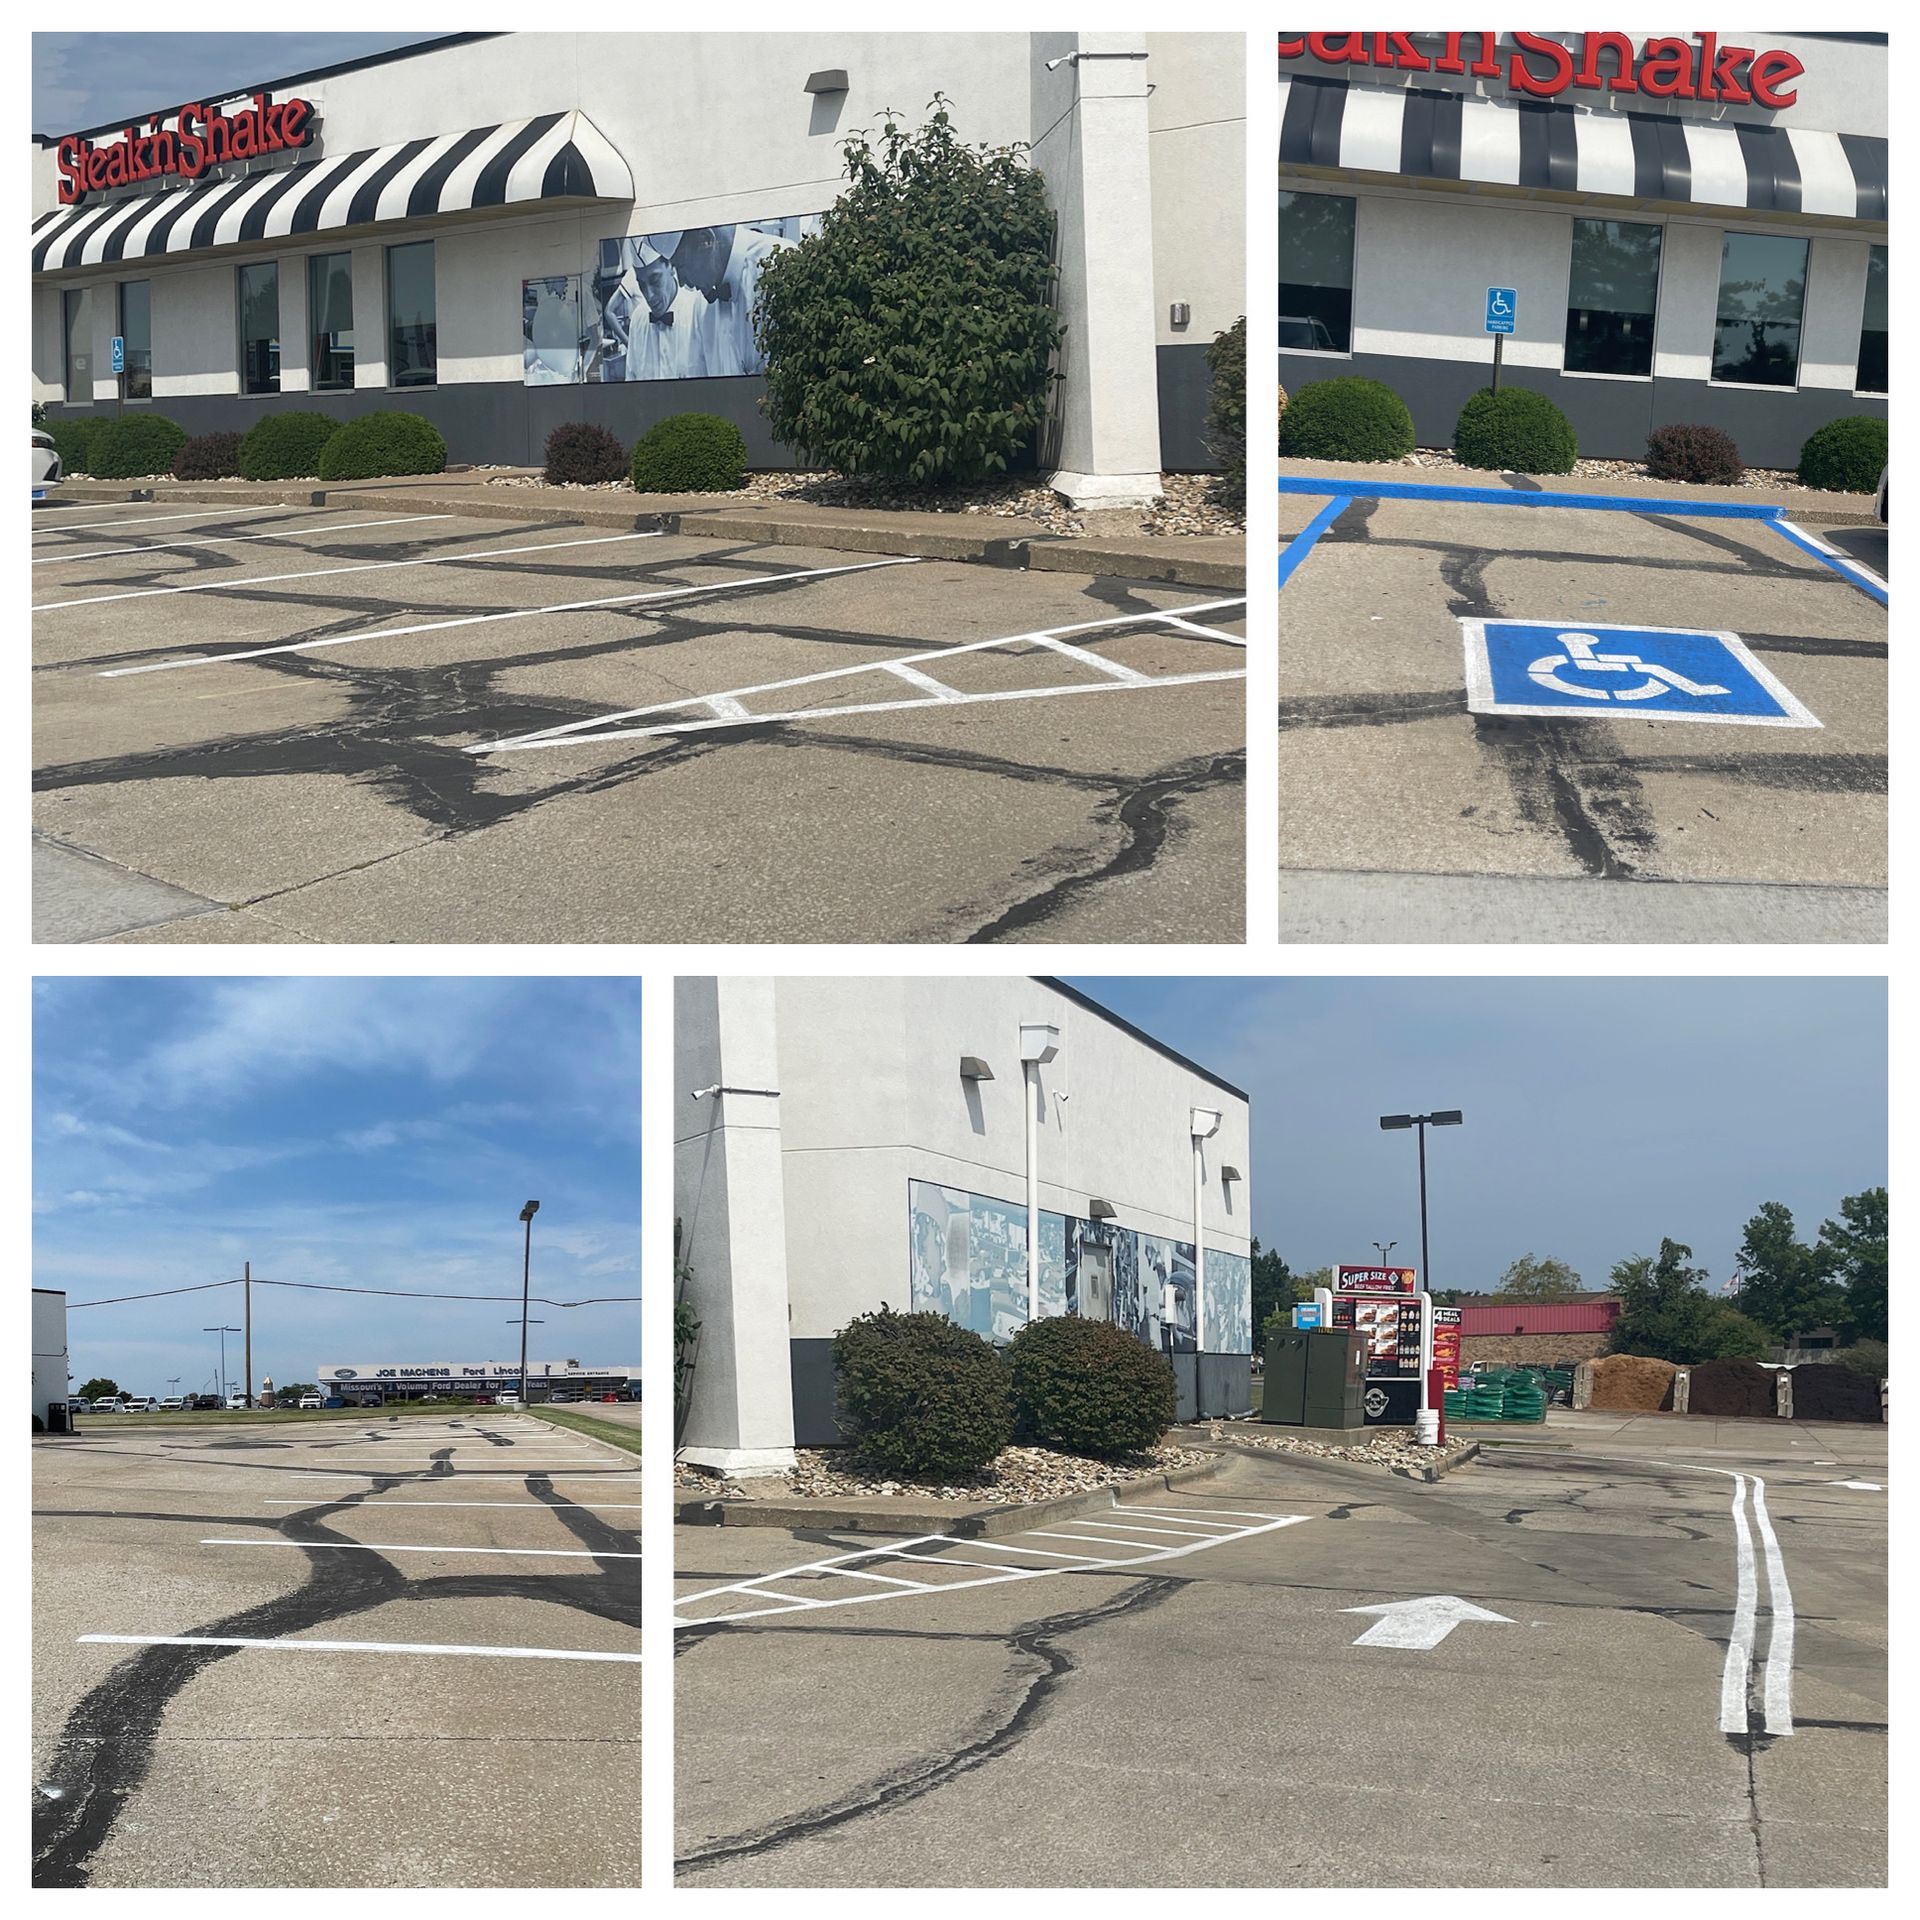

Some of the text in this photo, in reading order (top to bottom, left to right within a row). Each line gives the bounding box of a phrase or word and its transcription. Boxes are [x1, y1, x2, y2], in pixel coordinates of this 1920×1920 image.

[57, 92, 313, 205] Steak'n Shake
[1341, 1271, 1387, 1288] SUPER SIZE
[1435, 1311, 1443, 1322] 4
[376, 1369, 396, 1377] JOE
[400, 1368, 450, 1377] MACHENS
[463, 1367, 485, 1376] Ford
[341, 1383, 383, 1391] Missouri's
[396, 1382, 428, 1390] Volume
[432, 1382, 451, 1390] Ford
[454, 1381, 482, 1389] Dealer
[486, 1381, 499, 1389] for
[527, 1380, 547, 1388] Years
